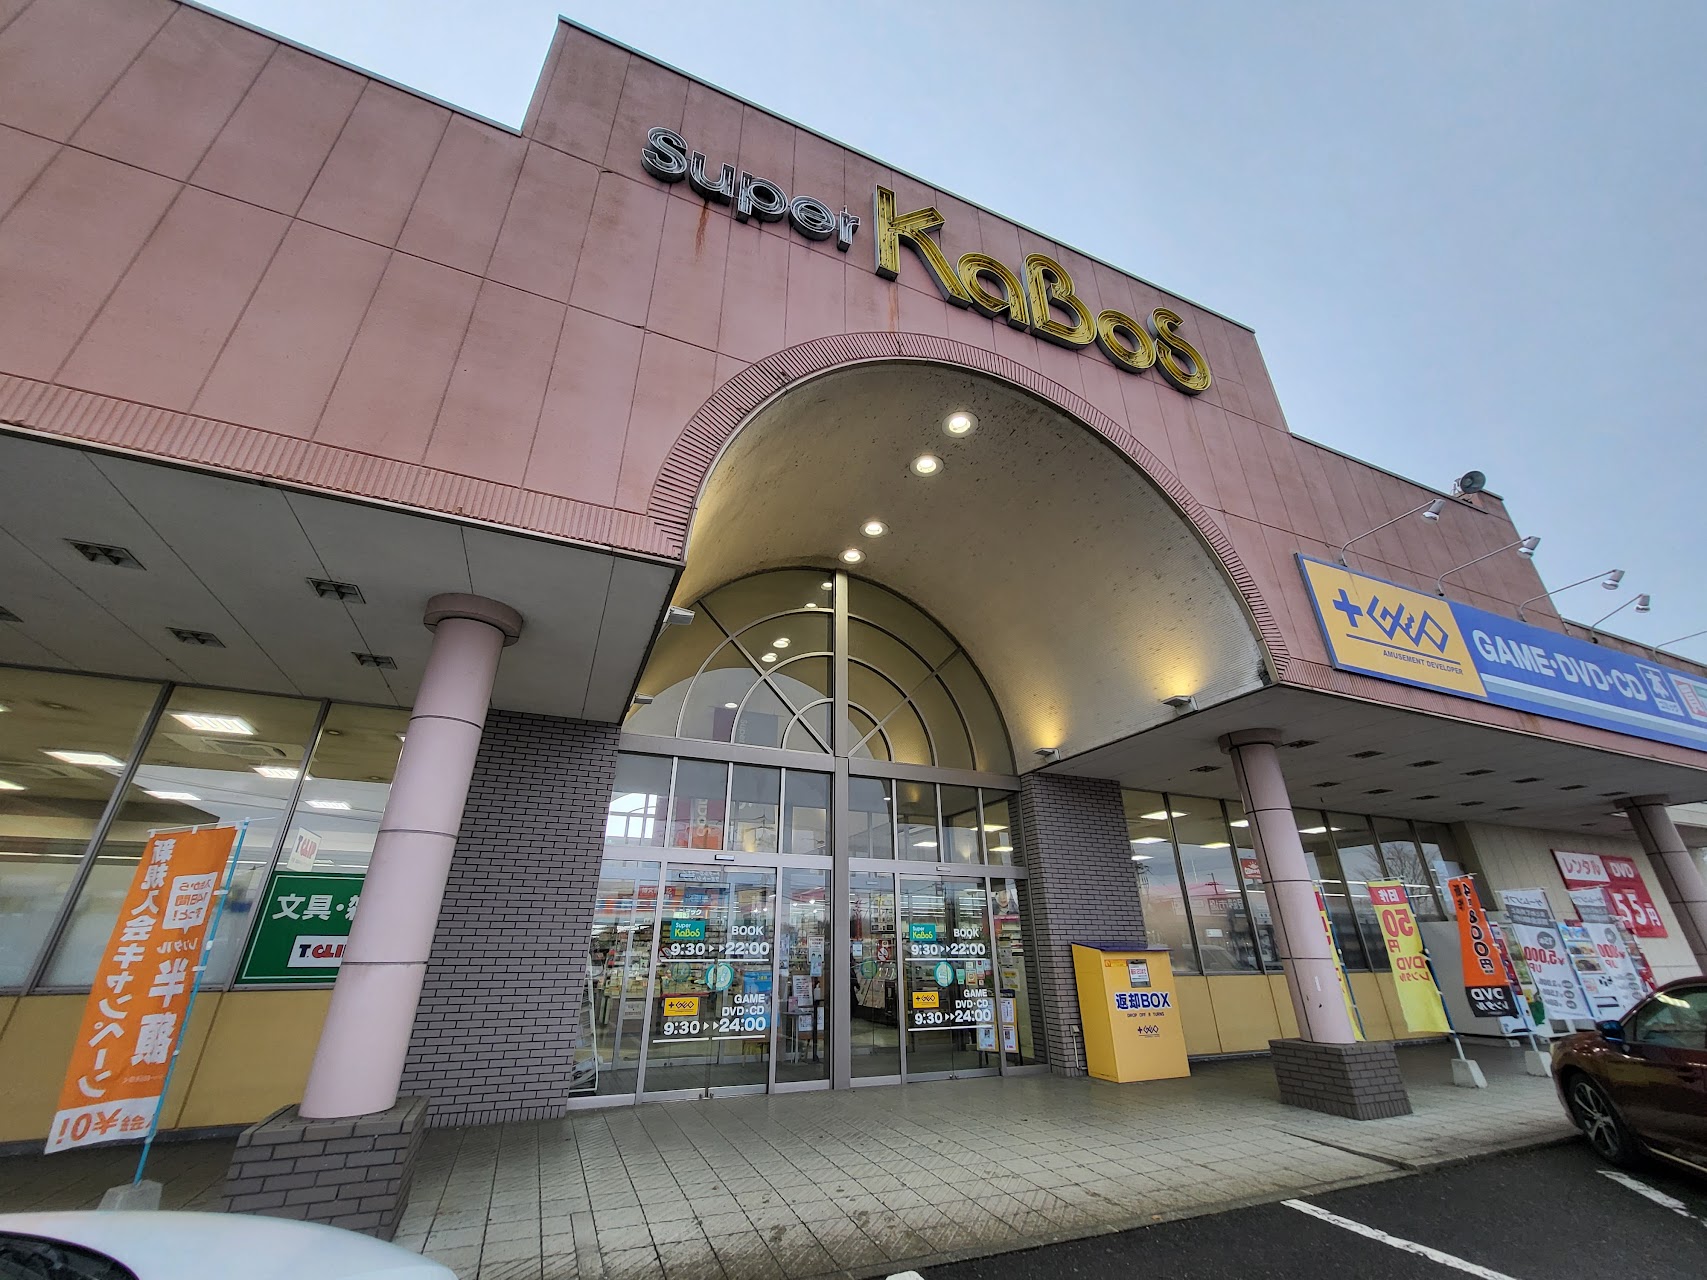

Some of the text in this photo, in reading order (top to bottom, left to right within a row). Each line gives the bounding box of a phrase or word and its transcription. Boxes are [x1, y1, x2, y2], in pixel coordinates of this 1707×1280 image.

[640, 126, 1212, 395] Super KaBoS
[1383, 650, 1464, 676] AMUSEMENT DEVELOPER
[1645, 670, 1670, 699] 本
[1562, 858, 1634, 878] レンタル DVD
[731, 925, 764, 936] BOOK
[953, 928, 980, 938] BOOK
[299, 943, 347, 959] T.CLI
[670, 941, 770, 956] 9:30 22:00
[911, 943, 986, 956] 9:30 22:00
[734, 993, 766, 1004] GAME
[963, 989, 988, 998] GAME
[1115, 992, 1171, 1010] 返却BOX
[914, 1009, 991, 1025] 9:30 24:00
[663, 1017, 767, 1036] 9:30 24:00
